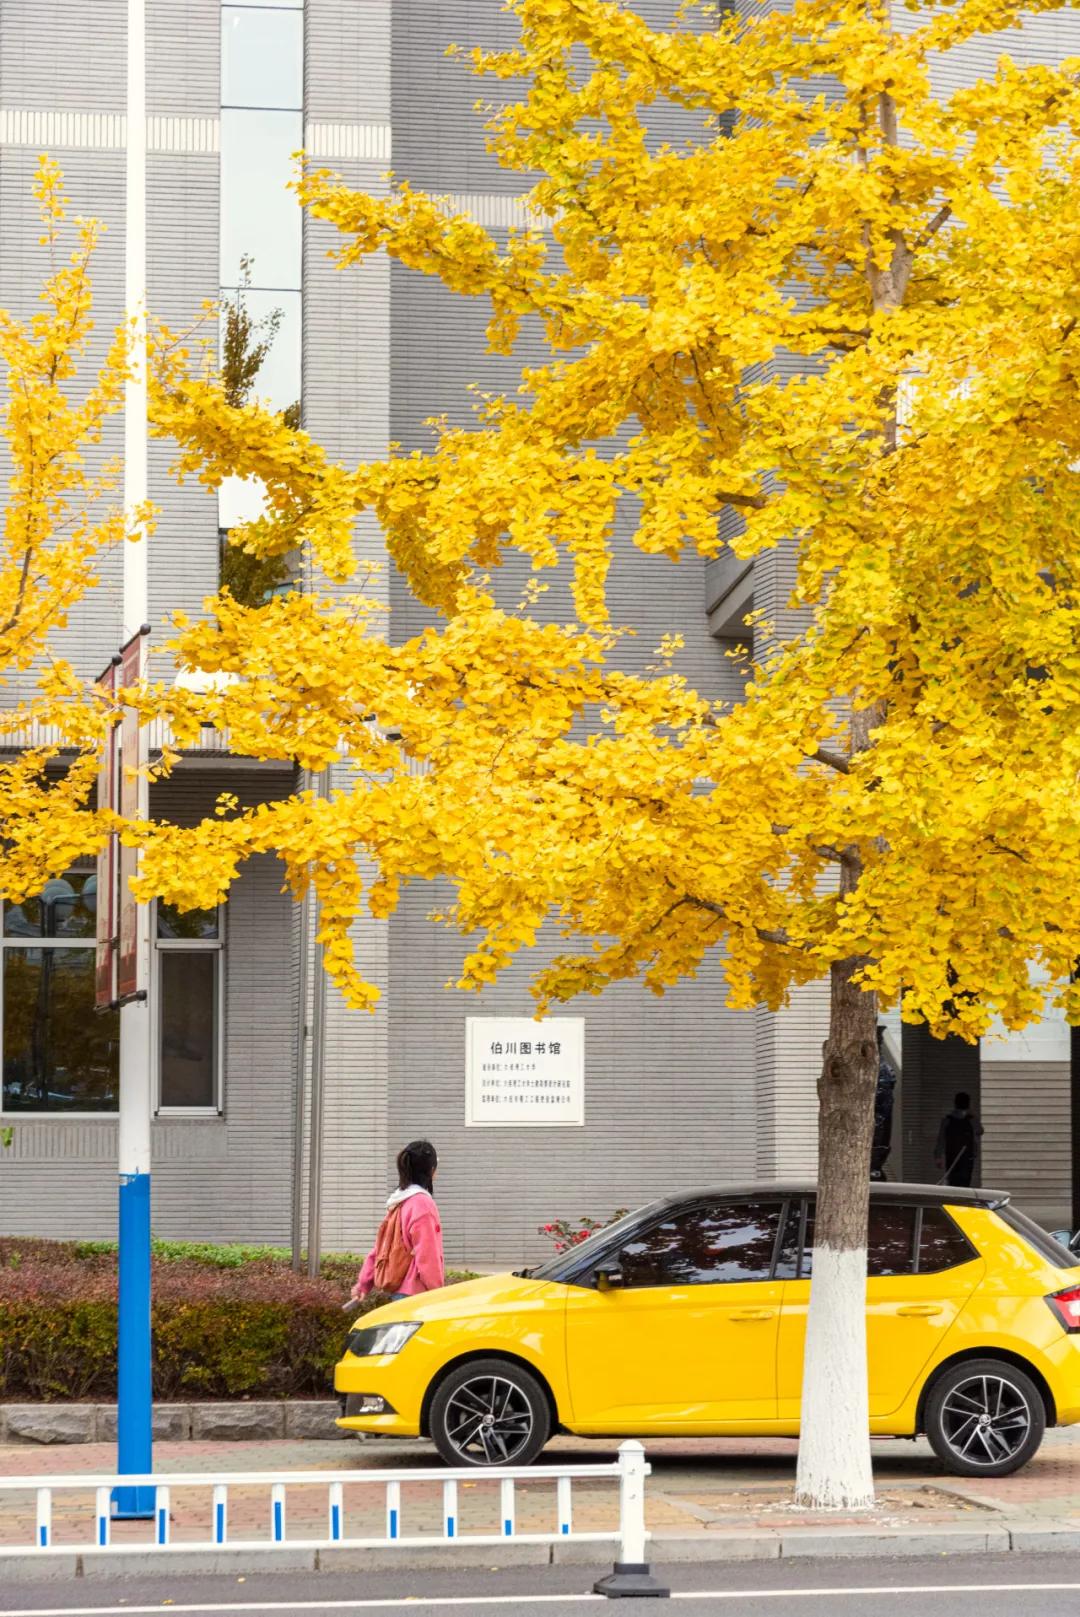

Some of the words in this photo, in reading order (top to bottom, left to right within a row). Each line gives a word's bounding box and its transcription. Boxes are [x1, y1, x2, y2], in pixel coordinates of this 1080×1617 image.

[491, 1041, 561, 1055] 伯川图书馆
